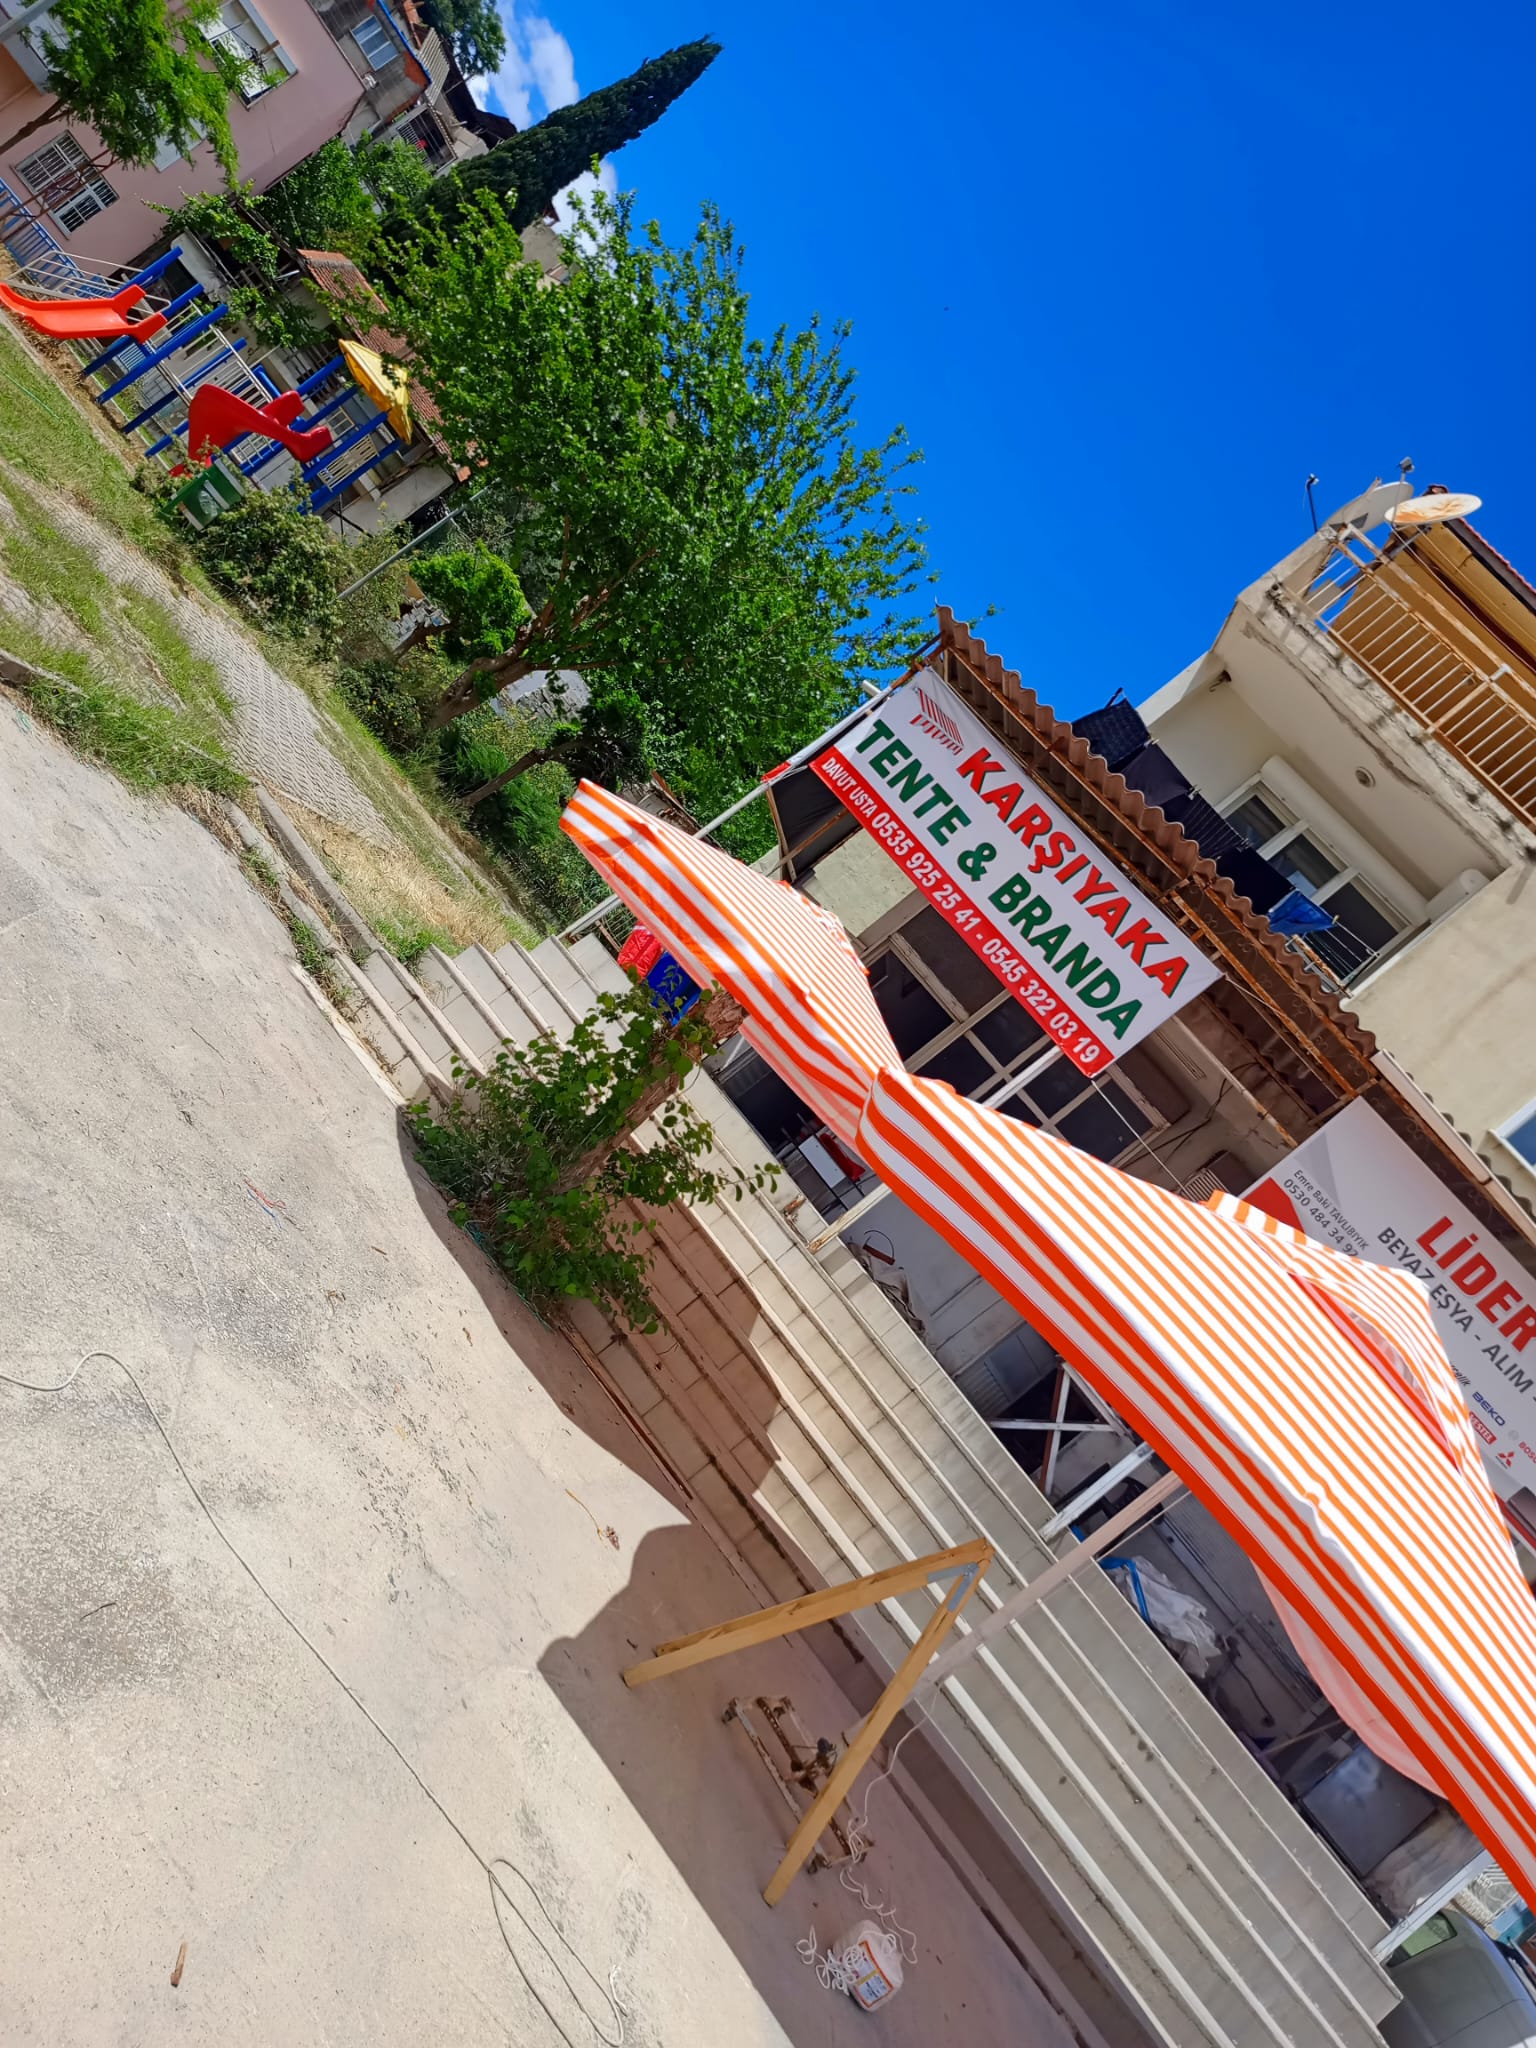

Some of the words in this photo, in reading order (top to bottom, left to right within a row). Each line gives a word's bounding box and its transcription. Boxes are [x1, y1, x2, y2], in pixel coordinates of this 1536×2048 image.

[821, 757, 857, 791] DAVUT
[850, 787, 878, 818] USTA
[871, 812, 915, 856] 0535
[906, 852, 942, 887] 925
[932, 884, 962, 910] 25
[954, 908, 982, 932] 41
[982, 938, 1028, 983] 0545
[1019, 979, 1057, 1017] 322
[1050, 1012, 1079, 1039] 03
[1072, 1036, 1100, 1063] 19
[856, 719, 972, 847] TENTE
[957, 842, 997, 882] &
[988, 872, 1143, 1040] BRANDA
[956, 746, 1189, 998] KARŞIYAKA
[1283, 1178, 1311, 1206] 0530
[1309, 1207, 1331, 1229] 484
[1327, 1227, 1345, 1244] 34
[1293, 1169, 1314, 1192] Emre
[1312, 1190, 1332, 1209] Baki
[1377, 1226, 1435, 1281] BEYAZ
[1429, 1283, 1474, 1333] EŞYA
[1481, 1344, 1535, 1394] ALIM
[1416, 1215, 1536, 1353] LİDER
[1472, 1391, 1506, 1427] BEKO
